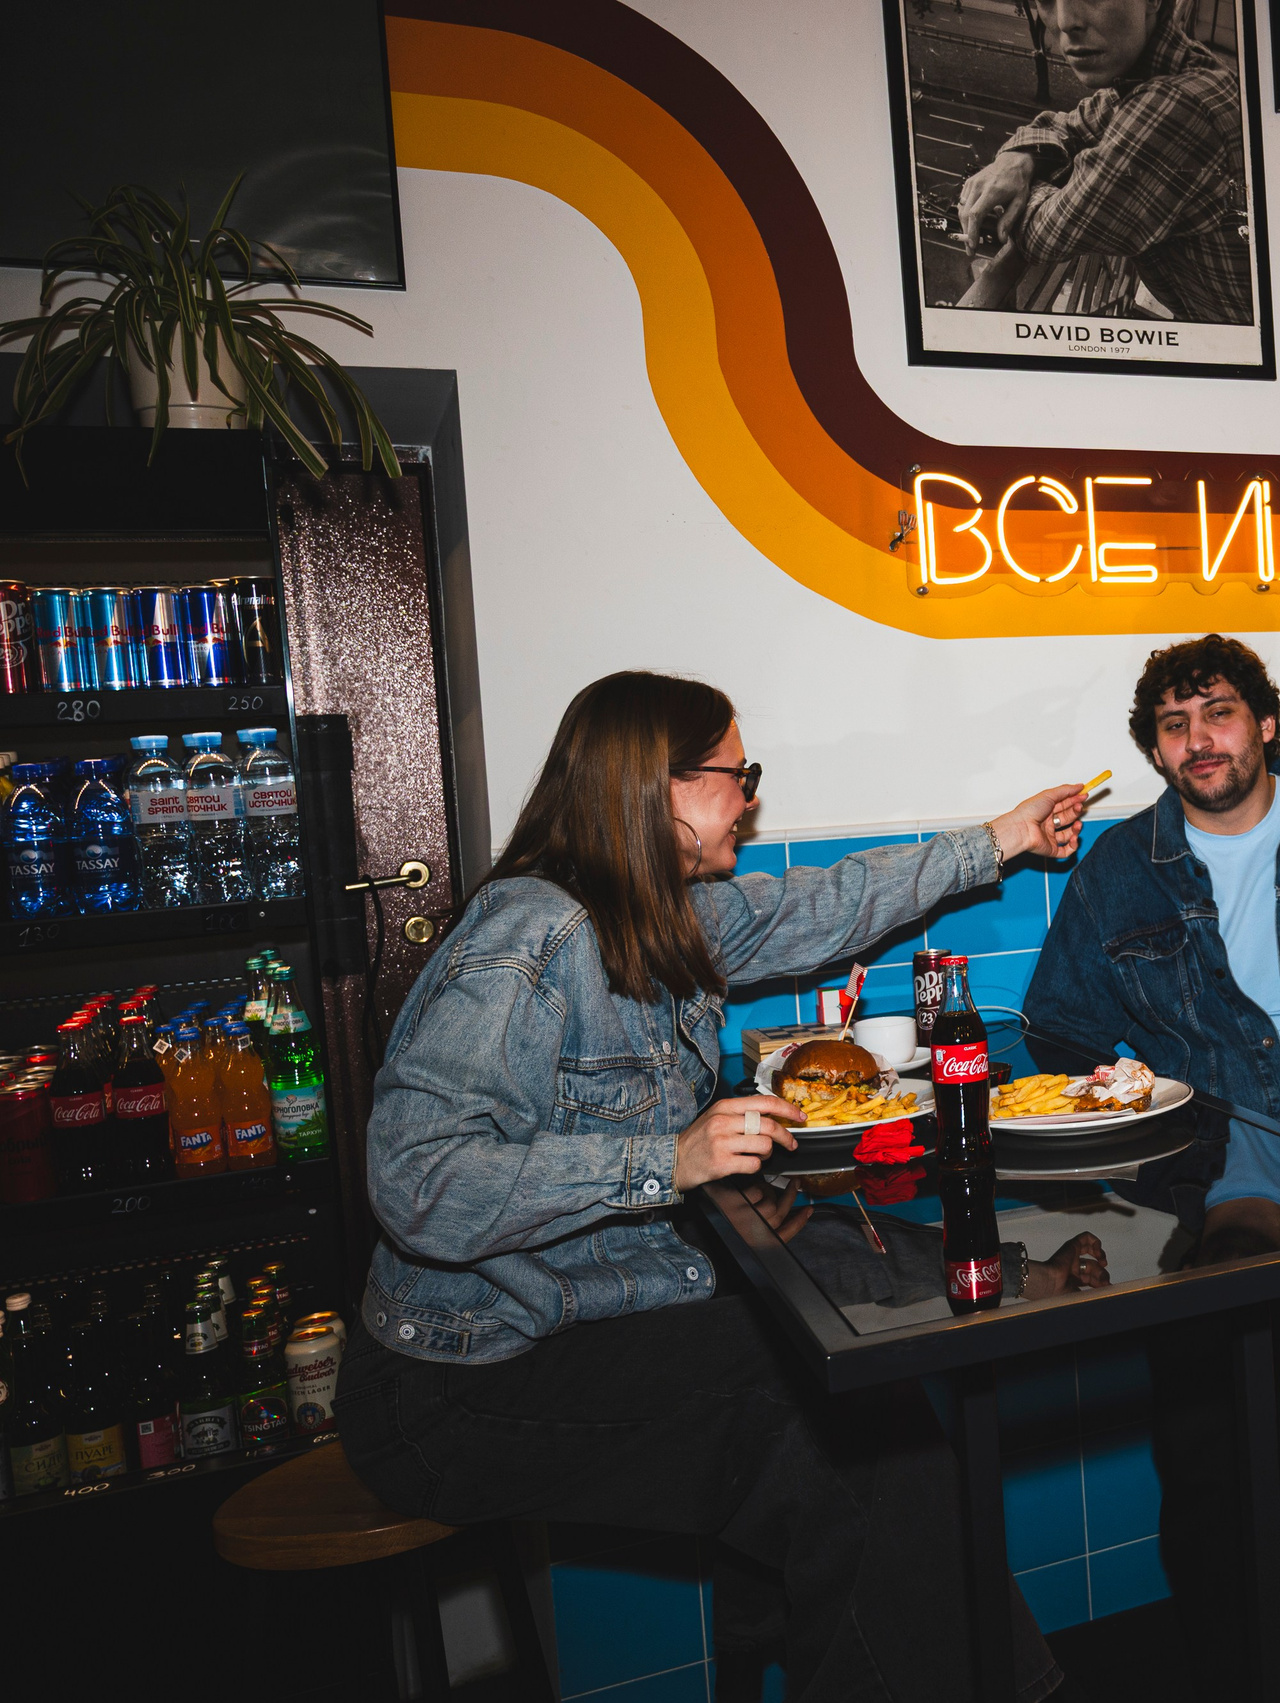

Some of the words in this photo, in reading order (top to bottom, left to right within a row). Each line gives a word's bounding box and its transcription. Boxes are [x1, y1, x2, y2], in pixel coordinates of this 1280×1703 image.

[1015, 323, 1091, 342] DAVID
[1100, 328, 1179, 347] BOWIE
[1068, 344, 1107, 353] LONDON
[912, 471, 1158, 585] ВСЕ
[151, 624, 178, 636] Bull
[57, 699, 101, 722] 280
[227, 696, 263, 711] 250
[253, 789, 292, 800] СВЯТОЙ
[187, 803, 228, 814] СТОЧНИК
[9, 863, 55, 876] TASSAY
[76, 857, 120, 871] TASSAY
[19, 923, 60, 948] 130
[924, 970, 945, 989] Dr
[914, 975, 944, 1006] Pepp
[921, 1011, 934, 1024] 23
[943, 1053, 988, 1078] Coca-Cola
[116, 1093, 160, 1113] Coca-Cola
[54, 1102, 100, 1122] Coca-Cola
[234, 1123, 267, 1140] FANTA
[299, 1128, 322, 1138] ТАРХУН
[180, 1132, 212, 1148] FANTA
[112, 1195, 151, 1214] 200
[244, 1343, 269, 1352] SINGTAO
[287, 1355, 337, 1376] udweiser
[307, 1385, 331, 1395] LAGER
[243, 1416, 287, 1433] TSINGTAO
[147, 1464, 196, 1480] 300
[64, 1482, 111, 1497] 400
